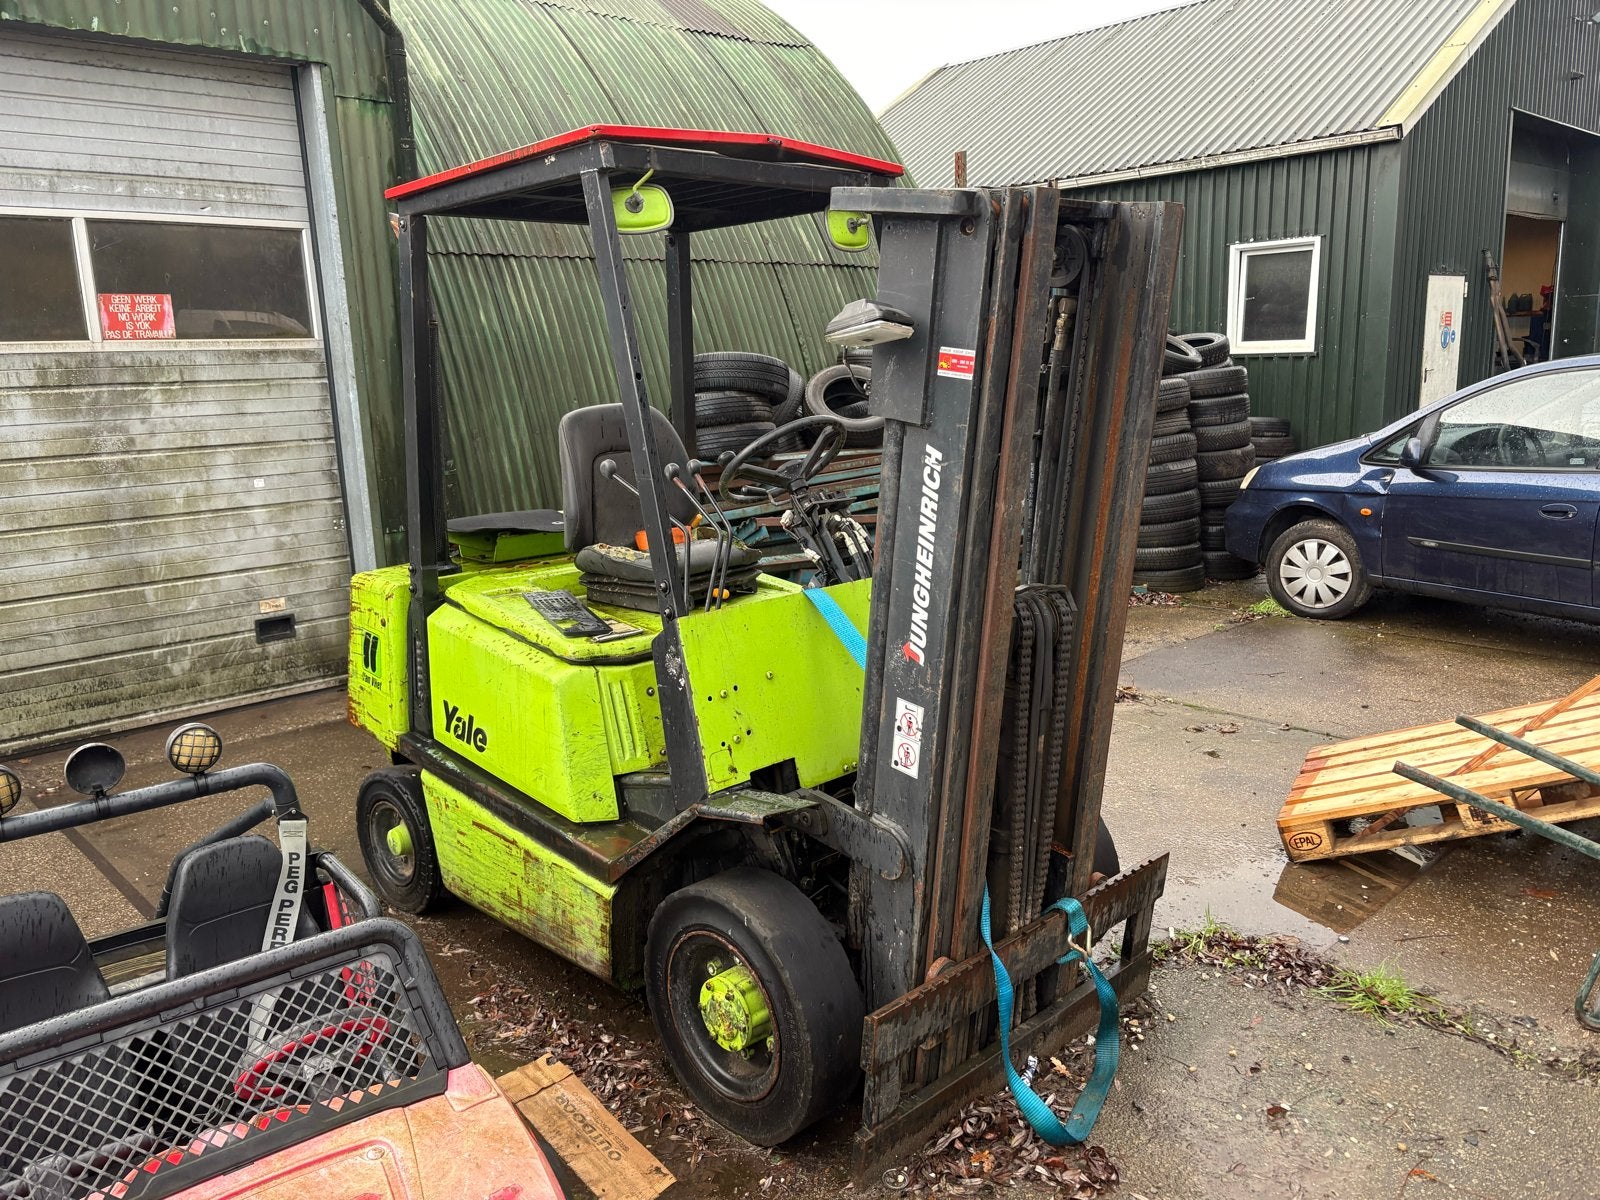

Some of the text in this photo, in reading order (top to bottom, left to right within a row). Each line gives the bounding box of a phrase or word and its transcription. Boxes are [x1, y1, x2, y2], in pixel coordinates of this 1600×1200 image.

[111, 295, 158, 304] GEEN WERK
[109, 304, 162, 312] KEINE ARBEIT
[117, 313, 157, 321] NO WORK
[126, 322, 134, 330] IS
[105, 330, 121, 339] PAS
[122, 330, 133, 338] DE
[902, 443, 943, 667] JUNGHEINRICH
[443, 699, 488, 753] Yale
[1293, 835, 1319, 849] EPAL
[284, 852, 301, 894] PEG
[555, 1093, 622, 1161] OUTDOOR
